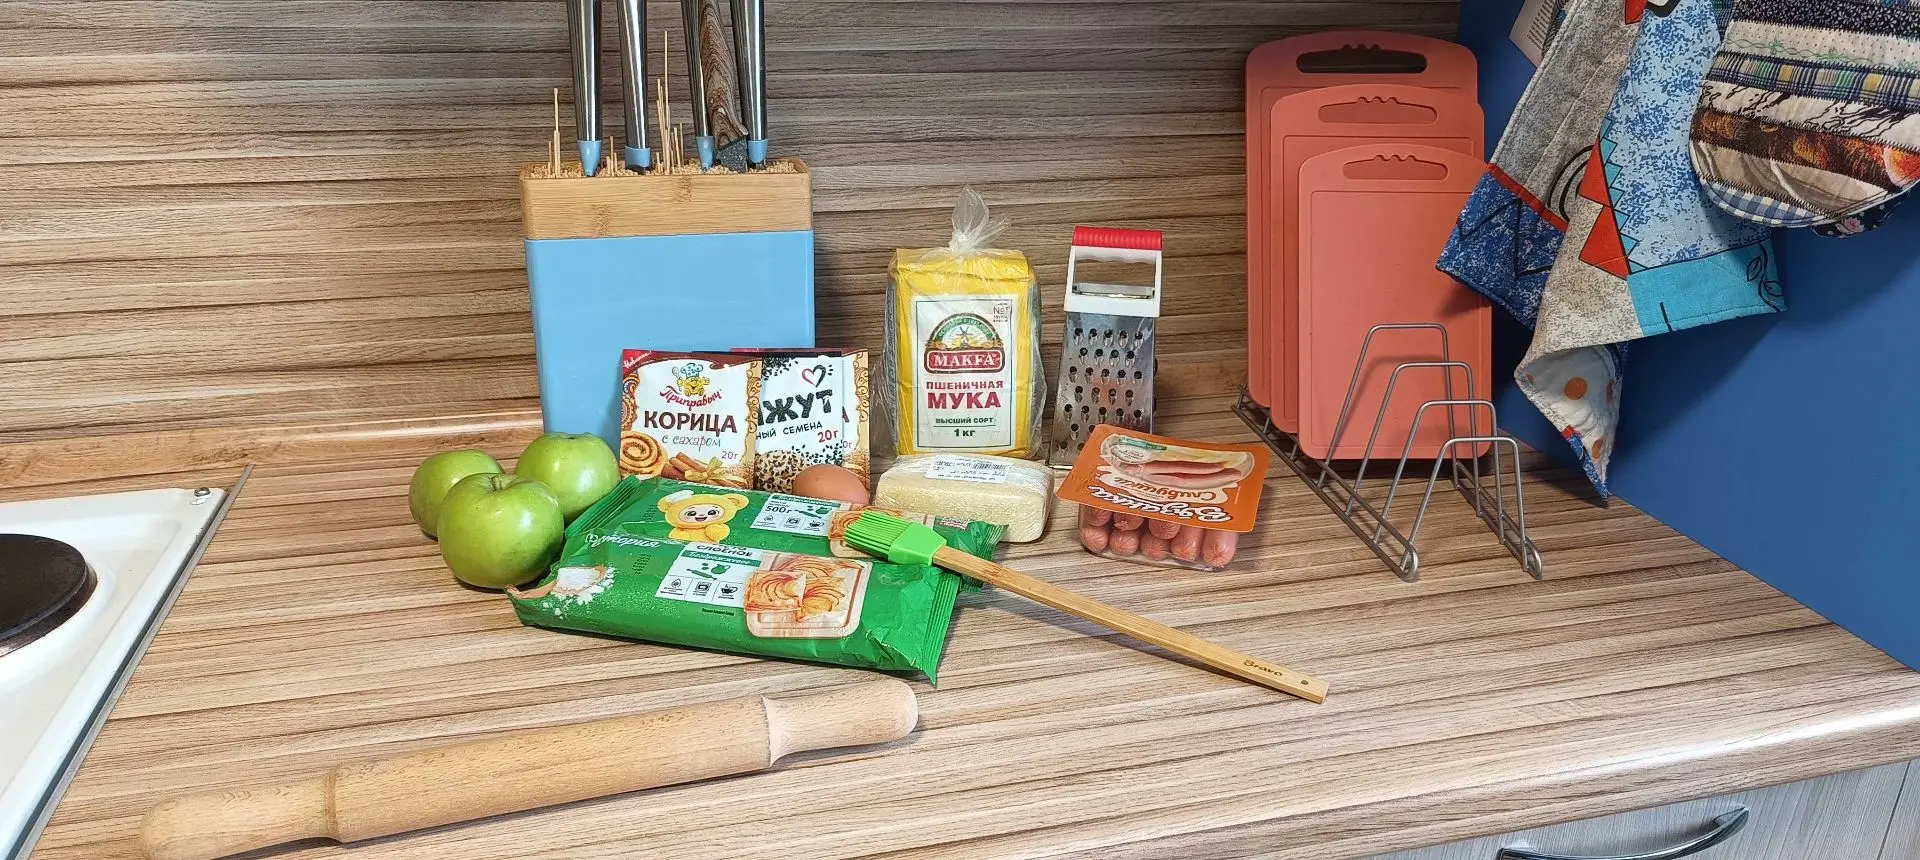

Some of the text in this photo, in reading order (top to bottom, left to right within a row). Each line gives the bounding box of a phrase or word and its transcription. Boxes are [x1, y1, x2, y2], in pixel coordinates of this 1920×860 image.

[933, 352, 997, 367] MAKFA
[926, 380, 1004, 390] ПШЕНИЧНАЯ
[659, 383, 722, 411] Приправыч
[927, 391, 1002, 409] МУКА
[643, 410, 738, 437] КОРИЦА
[783, 421, 823, 436] СЕМЕНА
[935, 416, 994, 425] ВЫСШИЙ СОРТ
[954, 429, 960, 437] 1
[672, 435, 722, 452] сахаром
[1114, 477, 1216, 501] Сливушки
[1087, 485, 1231, 522] Вязанка
[1243, 659, 1283, 677] Bravo
